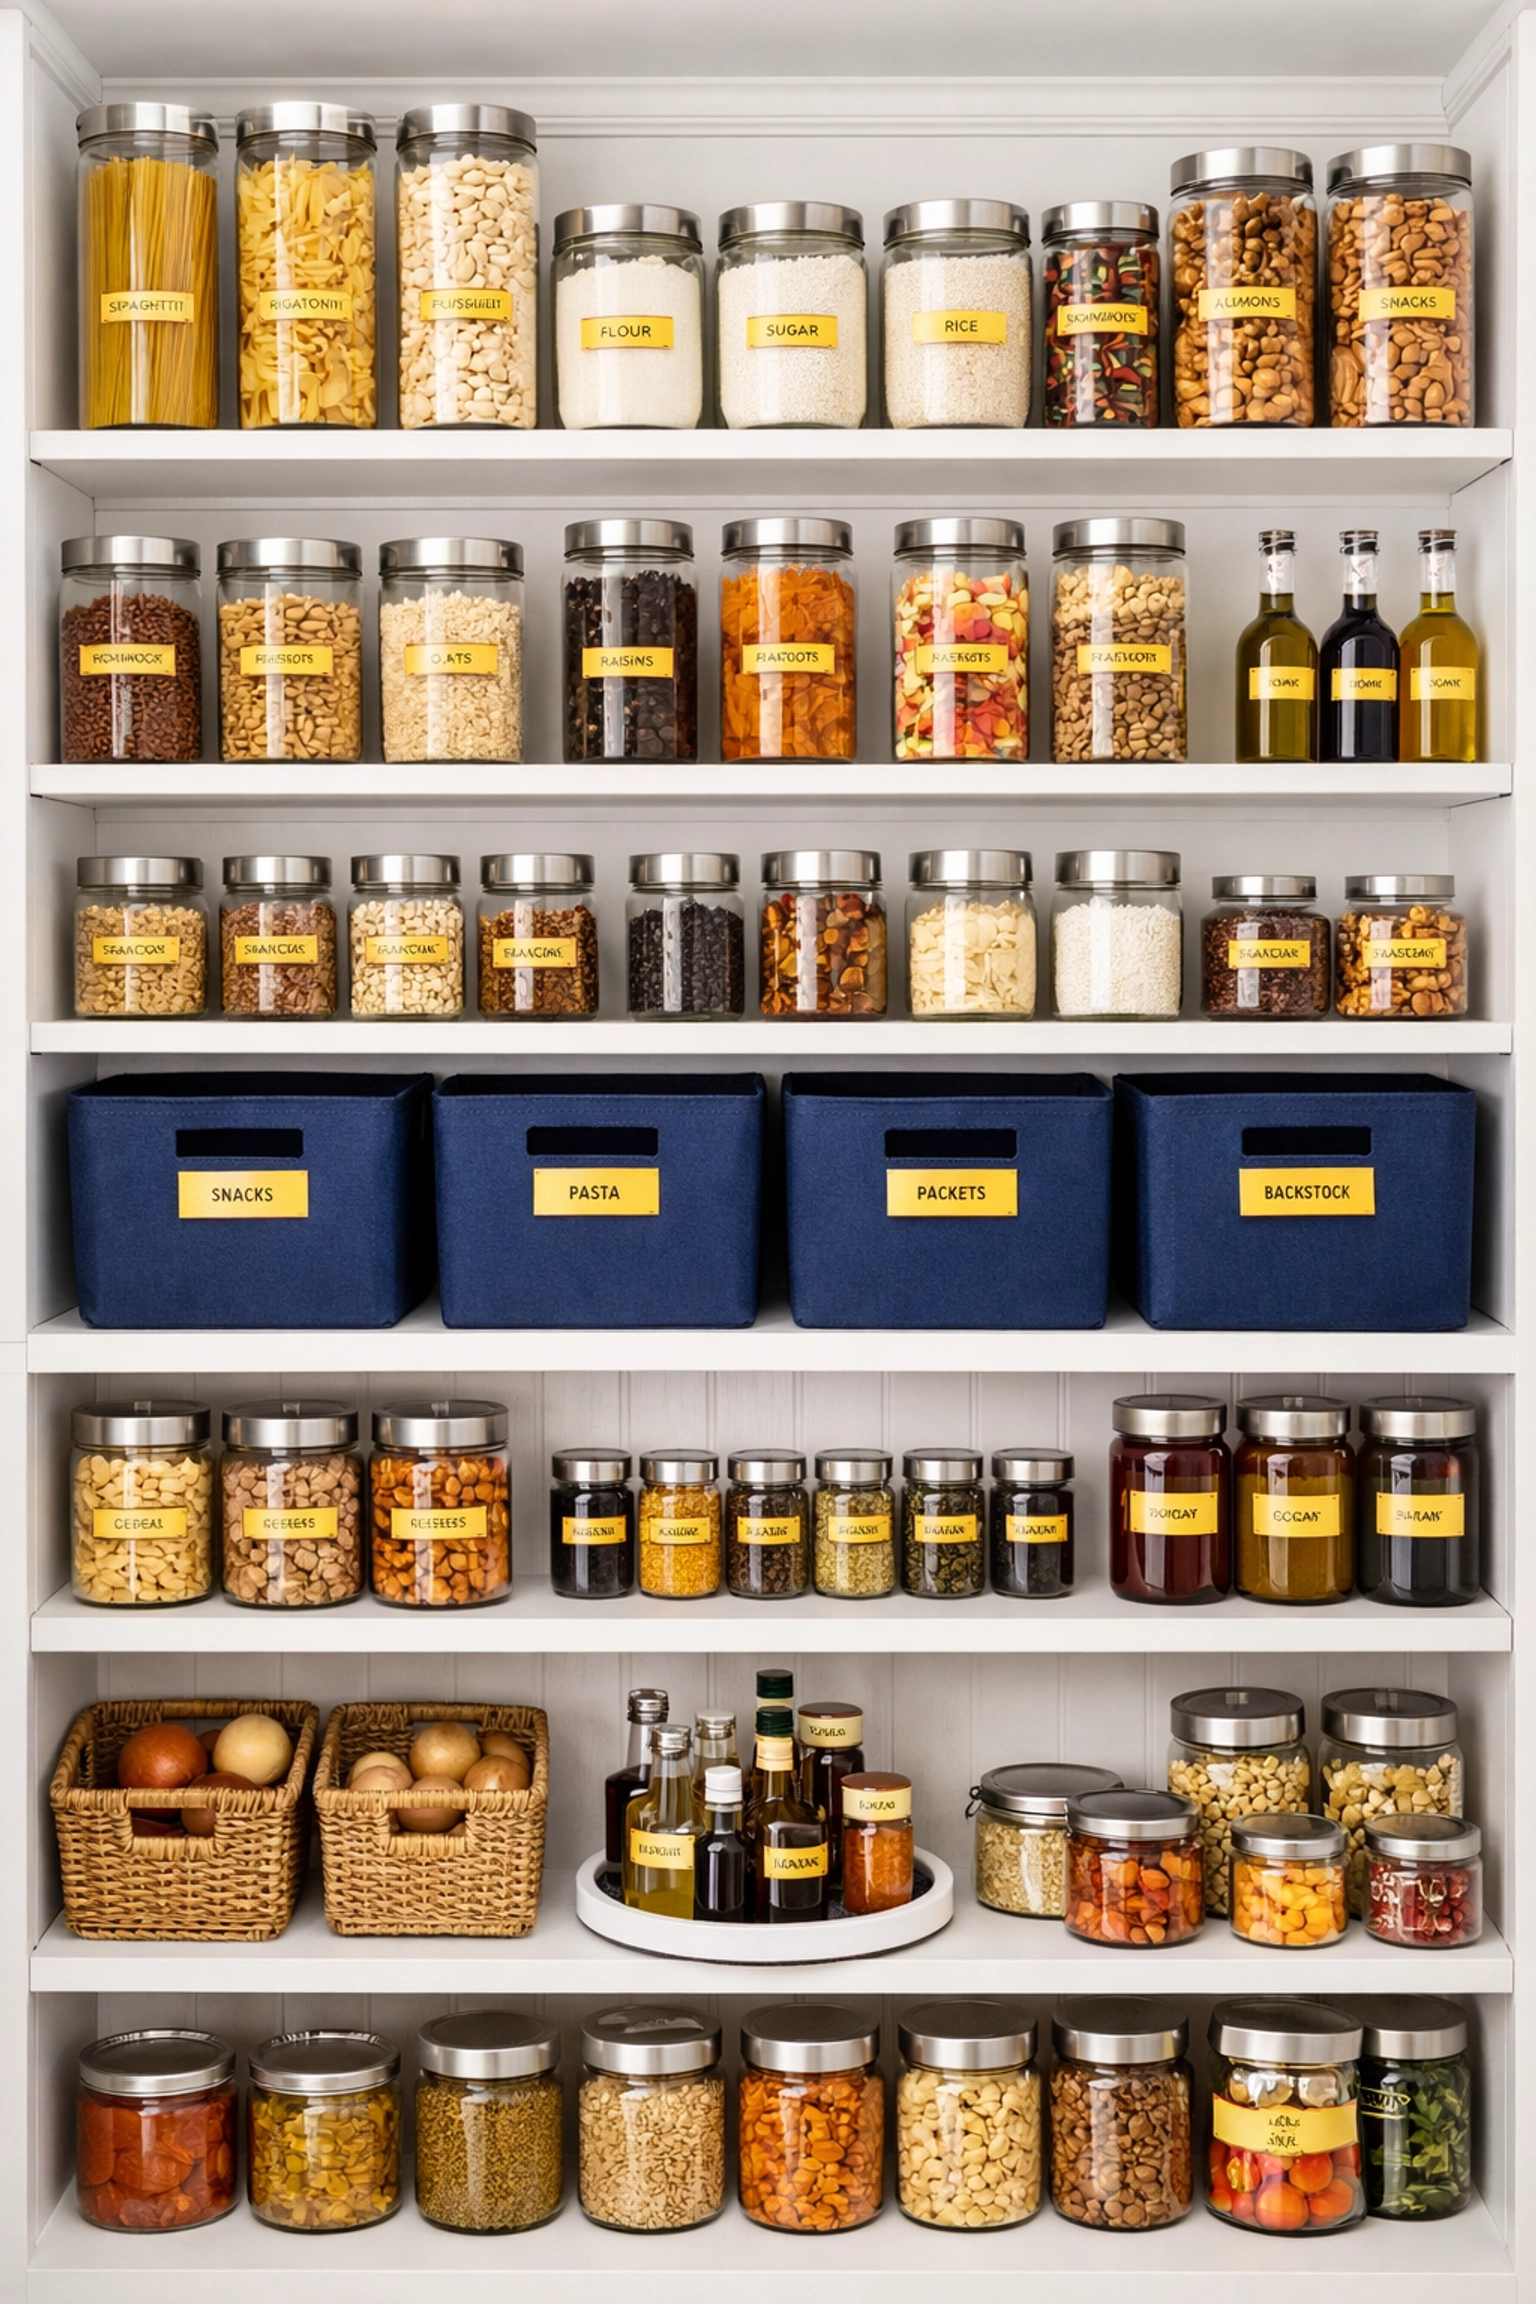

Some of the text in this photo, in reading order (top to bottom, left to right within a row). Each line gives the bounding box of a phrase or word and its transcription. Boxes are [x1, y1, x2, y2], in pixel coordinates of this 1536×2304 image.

[1380, 296, 1437, 309] SNACKS
[600, 325, 652, 338] FLOUR
[766, 324, 819, 337] SUGAR
[945, 320, 978, 332] RICE
[211, 1187, 274, 1203] SNACKS
[569, 1185, 621, 1200] PASTA
[917, 1185, 986, 1201] PACKETS
[1264, 1184, 1351, 1200] BACKSTOCK
